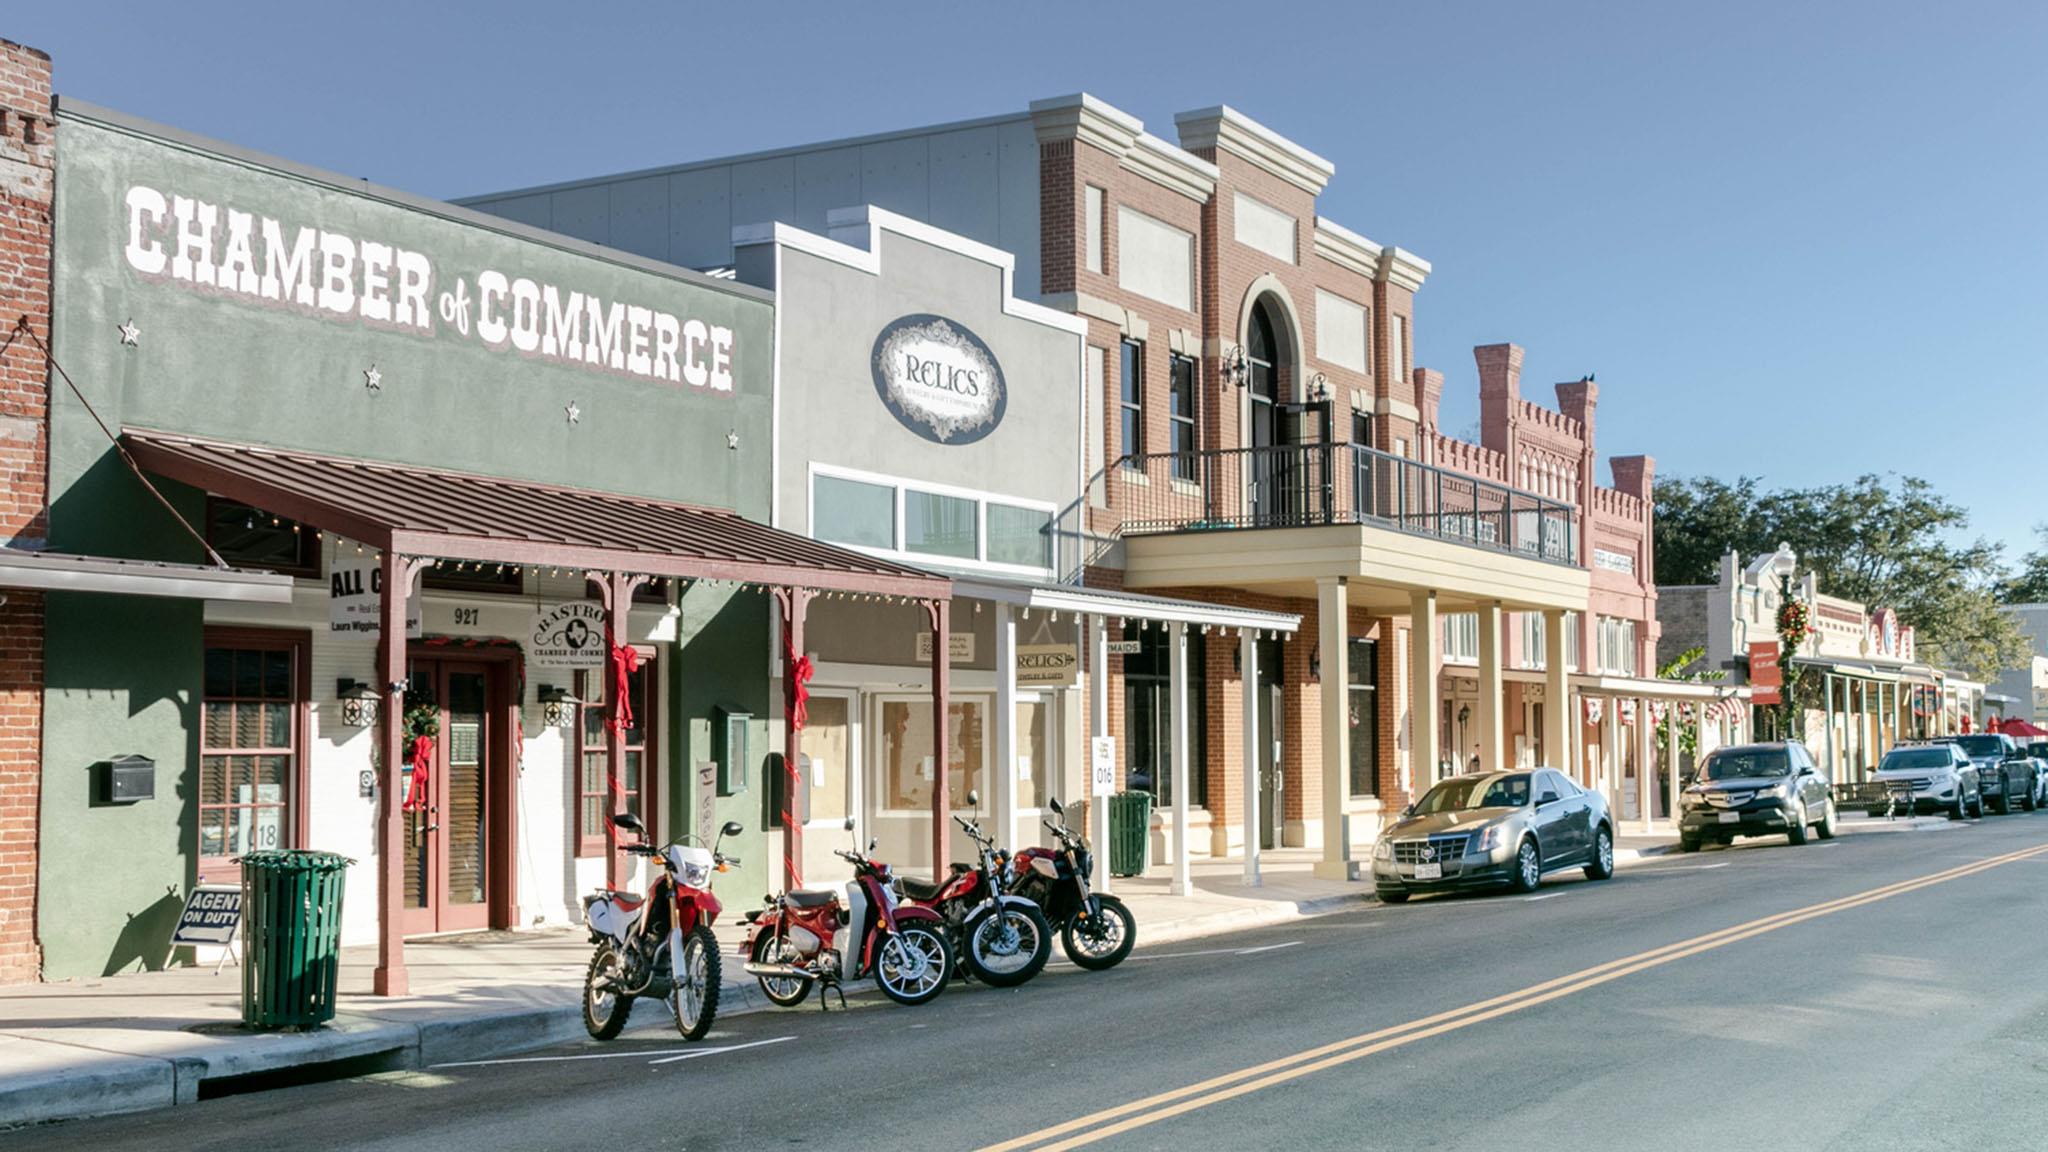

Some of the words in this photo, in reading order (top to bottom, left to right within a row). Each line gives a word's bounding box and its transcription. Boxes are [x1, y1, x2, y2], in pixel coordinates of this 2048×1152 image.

[125, 186, 433, 331] CHAMBER
[439, 277, 471, 336] of
[477, 269, 733, 394] COMMERCE
[906, 354, 979, 398] RELICS
[331, 569, 364, 598] ALL
[454, 607, 479, 626] 927
[537, 604, 605, 633] BASTRO
[580, 649, 604, 657] COMME
[1096, 767, 1113, 784] 016
[189, 893, 242, 910] AGENT
[184, 911, 203, 923] ON
[204, 912, 239, 924] DUTY
